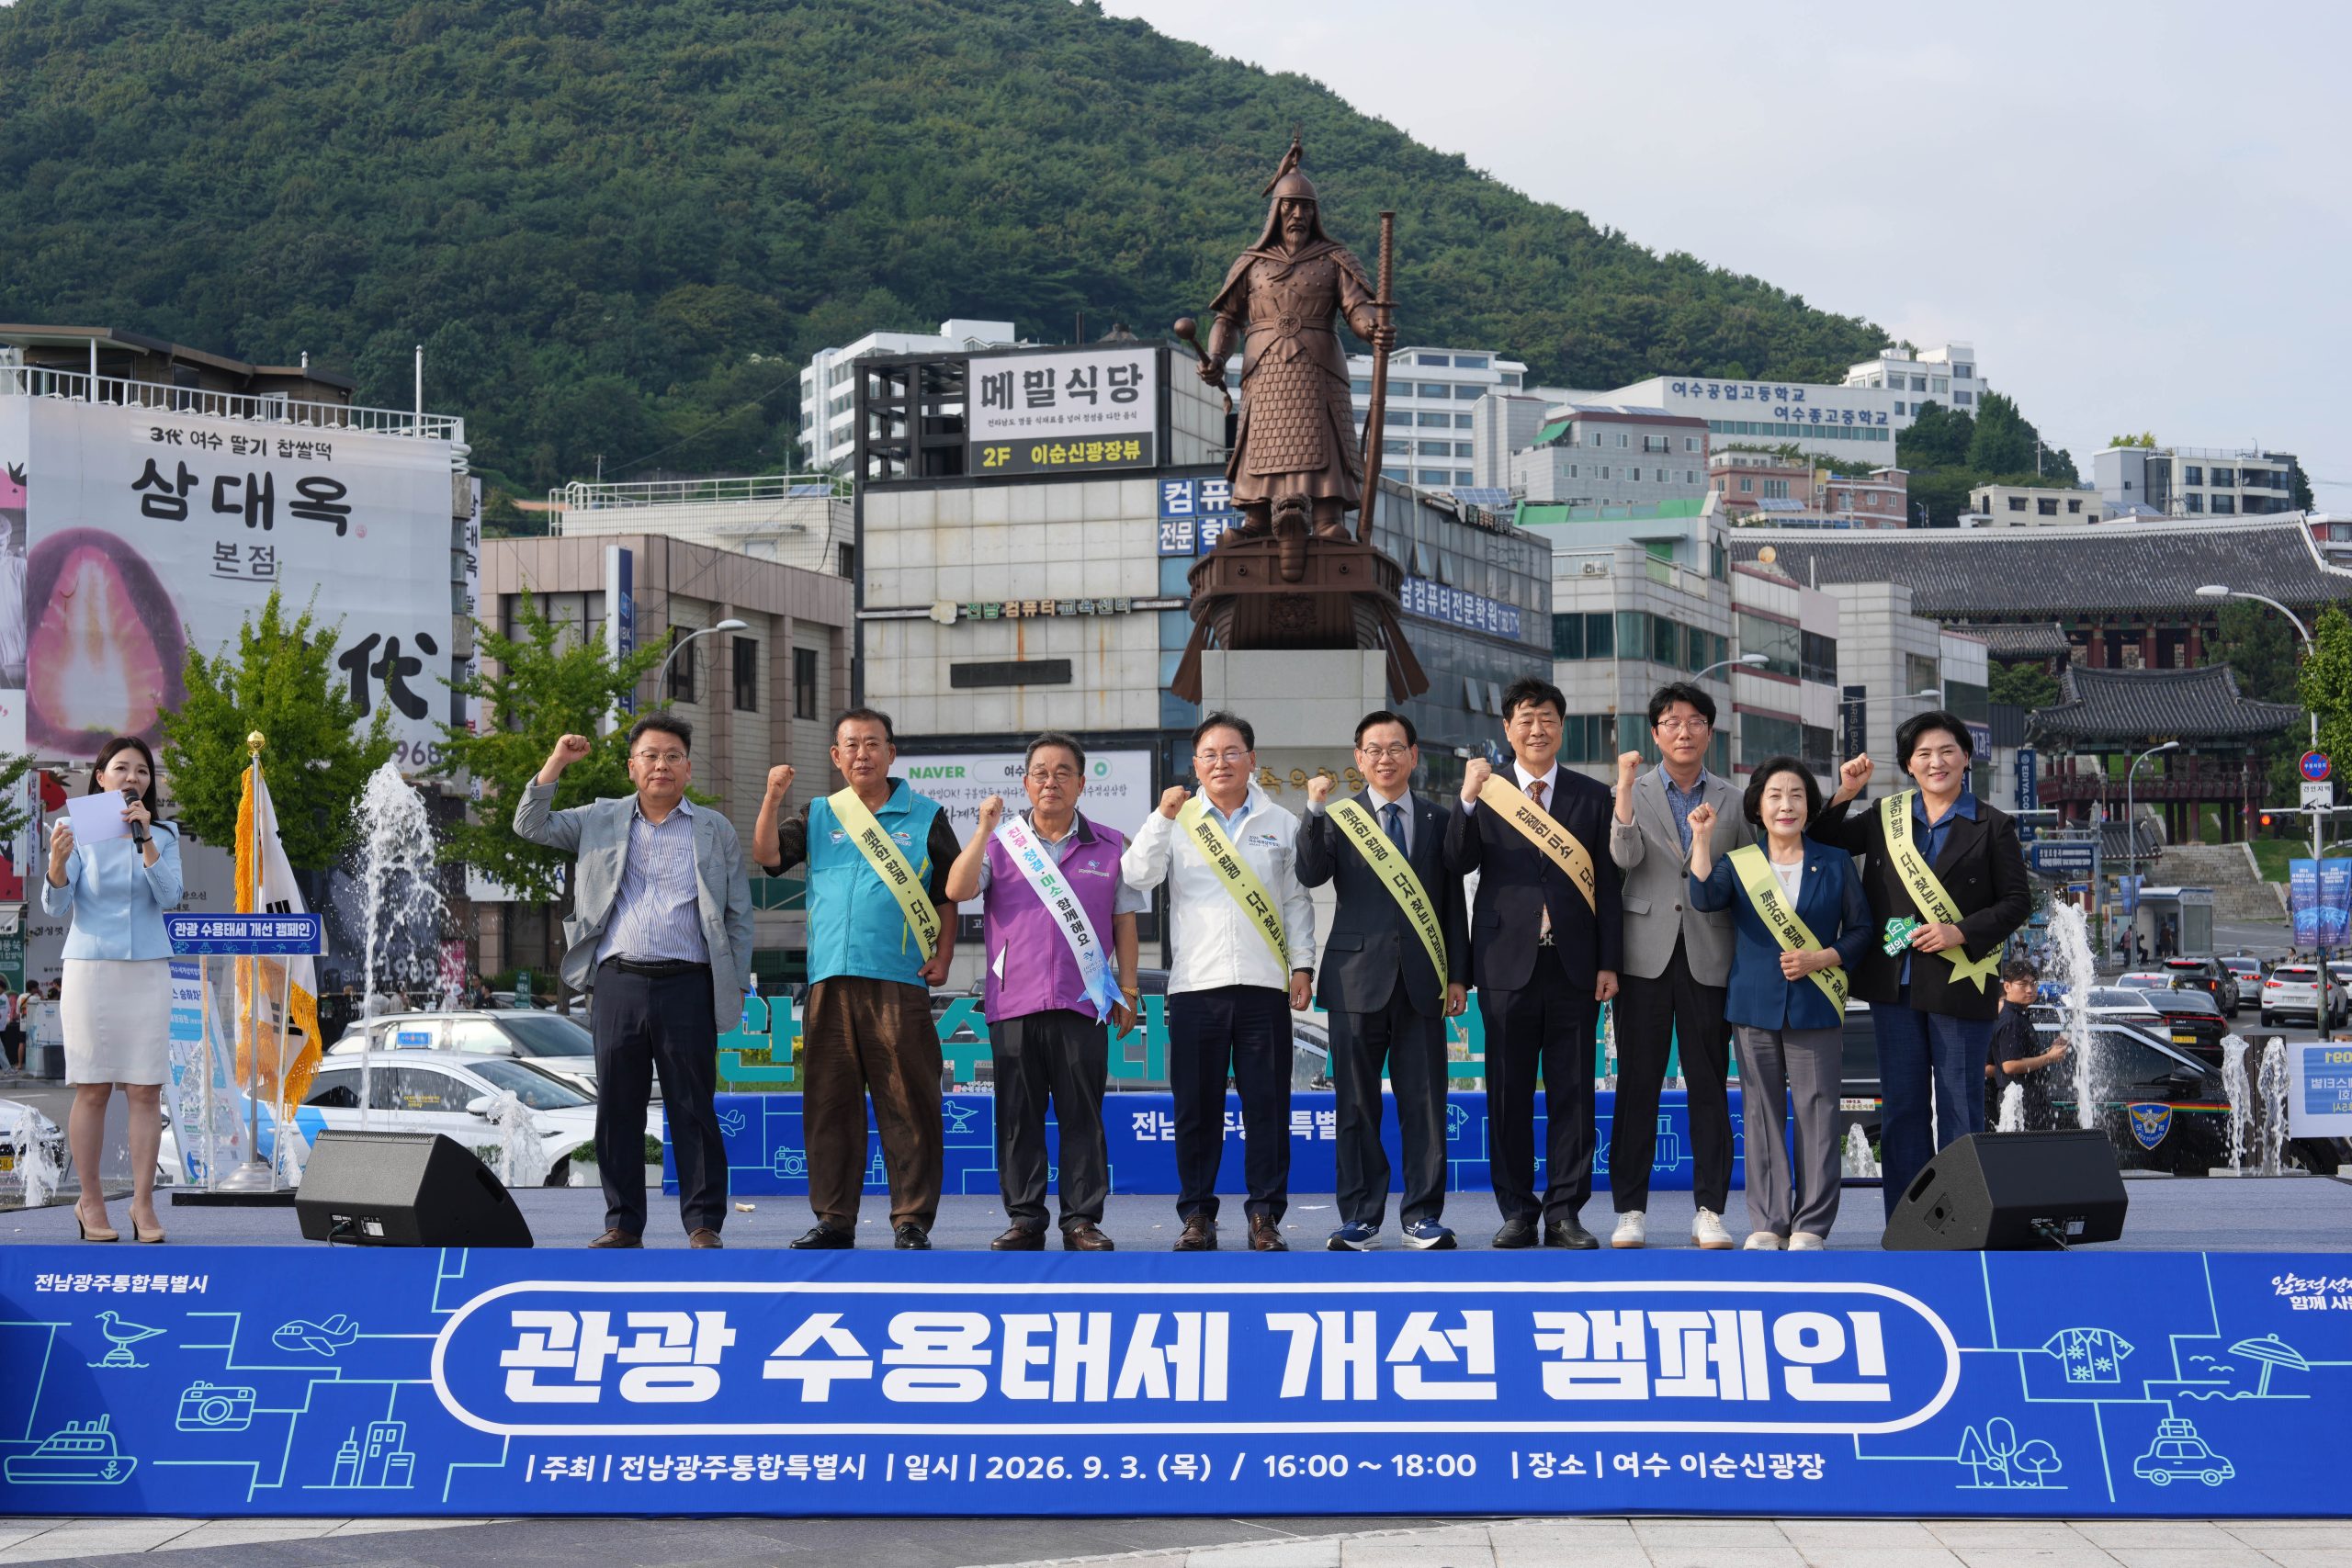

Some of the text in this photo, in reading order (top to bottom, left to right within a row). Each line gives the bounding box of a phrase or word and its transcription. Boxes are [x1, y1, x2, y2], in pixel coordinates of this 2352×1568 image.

[980, 362, 1144, 410] 메밀식당
[1671, 381, 1805, 403] 여수공업고등학교
[189, 430, 223, 452] 여수
[231, 434, 267, 457] 딸기
[277, 438, 332, 462] 찹쌀떡
[983, 439, 1142, 468] 2F 이순신광장뷰
[130, 458, 353, 537] 삼대옥
[1164, 479, 1231, 513] 컴퓨
[212, 540, 276, 576] 본점
[909, 766, 965, 779] NAVER
[1515, 806, 1551, 838] 친절한
[1547, 833, 1574, 859] 미소
[861, 828, 888, 862] 깨끗한
[884, 859, 908, 885] 환경
[910, 899, 931, 927] 다시
[1195, 822, 1281, 942] 깨끗한 환경 다시 찾는
[1339, 807, 1371, 840] 깨끗한
[1364, 836, 1389, 862] 환경
[1392, 872, 1416, 899] 다시
[1409, 897, 1430, 926] 찾는
[1900, 852, 1920, 879] 다시
[1914, 876, 1933, 905] 찾는
[175, 922, 310, 937] 관광 수용태세 개선 캠페인
[1056, 897, 1091, 947] 함께해요
[1759, 889, 1788, 928] 깨끗한
[1781, 924, 1806, 949] 환경
[35, 1273, 208, 1295] 전남광주통합특별시
[2290, 1295, 2327, 1311] 함께
[500, 1310, 1892, 1404] 관광 수용태세 개선 캠페인
[618, 1453, 866, 1483] 전남광주통합특별시
[987, 1455, 1073, 1481] 2026.
[1083, 1455, 1110, 1481] 9.
[1120, 1455, 1147, 1481] 3.
[1157, 1453, 1211, 1483] (목)
[1263, 1454, 1349, 1478] 16:00
[1391, 1454, 1476, 1478] 18:00
[1612, 1453, 1671, 1479] 여수
[1680, 1452, 1826, 1481] 이순신광장
